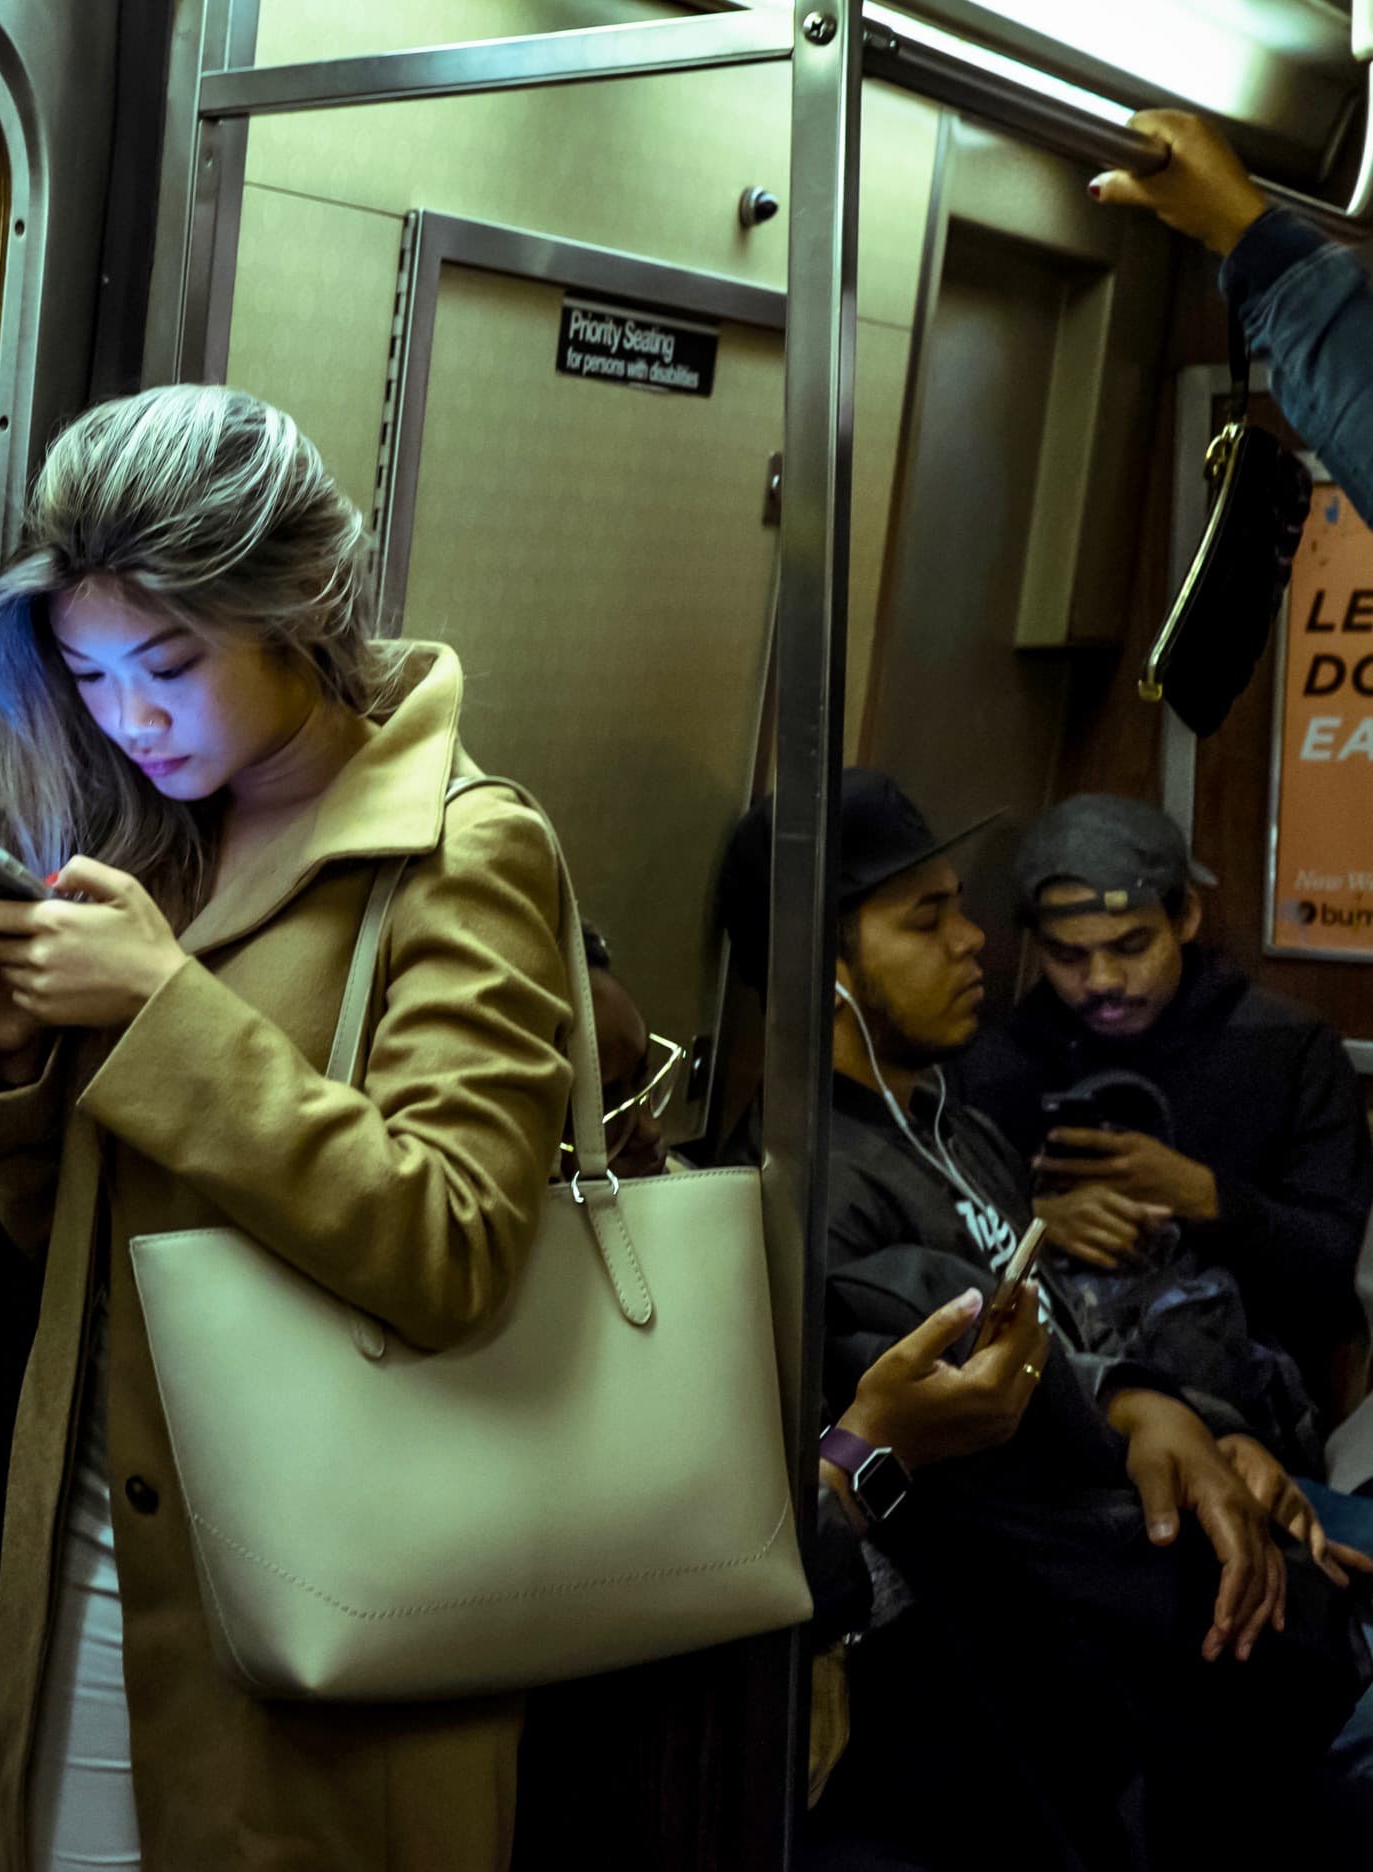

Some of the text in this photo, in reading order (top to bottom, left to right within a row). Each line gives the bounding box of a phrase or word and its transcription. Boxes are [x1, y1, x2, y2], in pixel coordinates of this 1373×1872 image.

[569, 310, 676, 363] Priority Seating
[566, 346, 699, 389] for persons with disabilities
